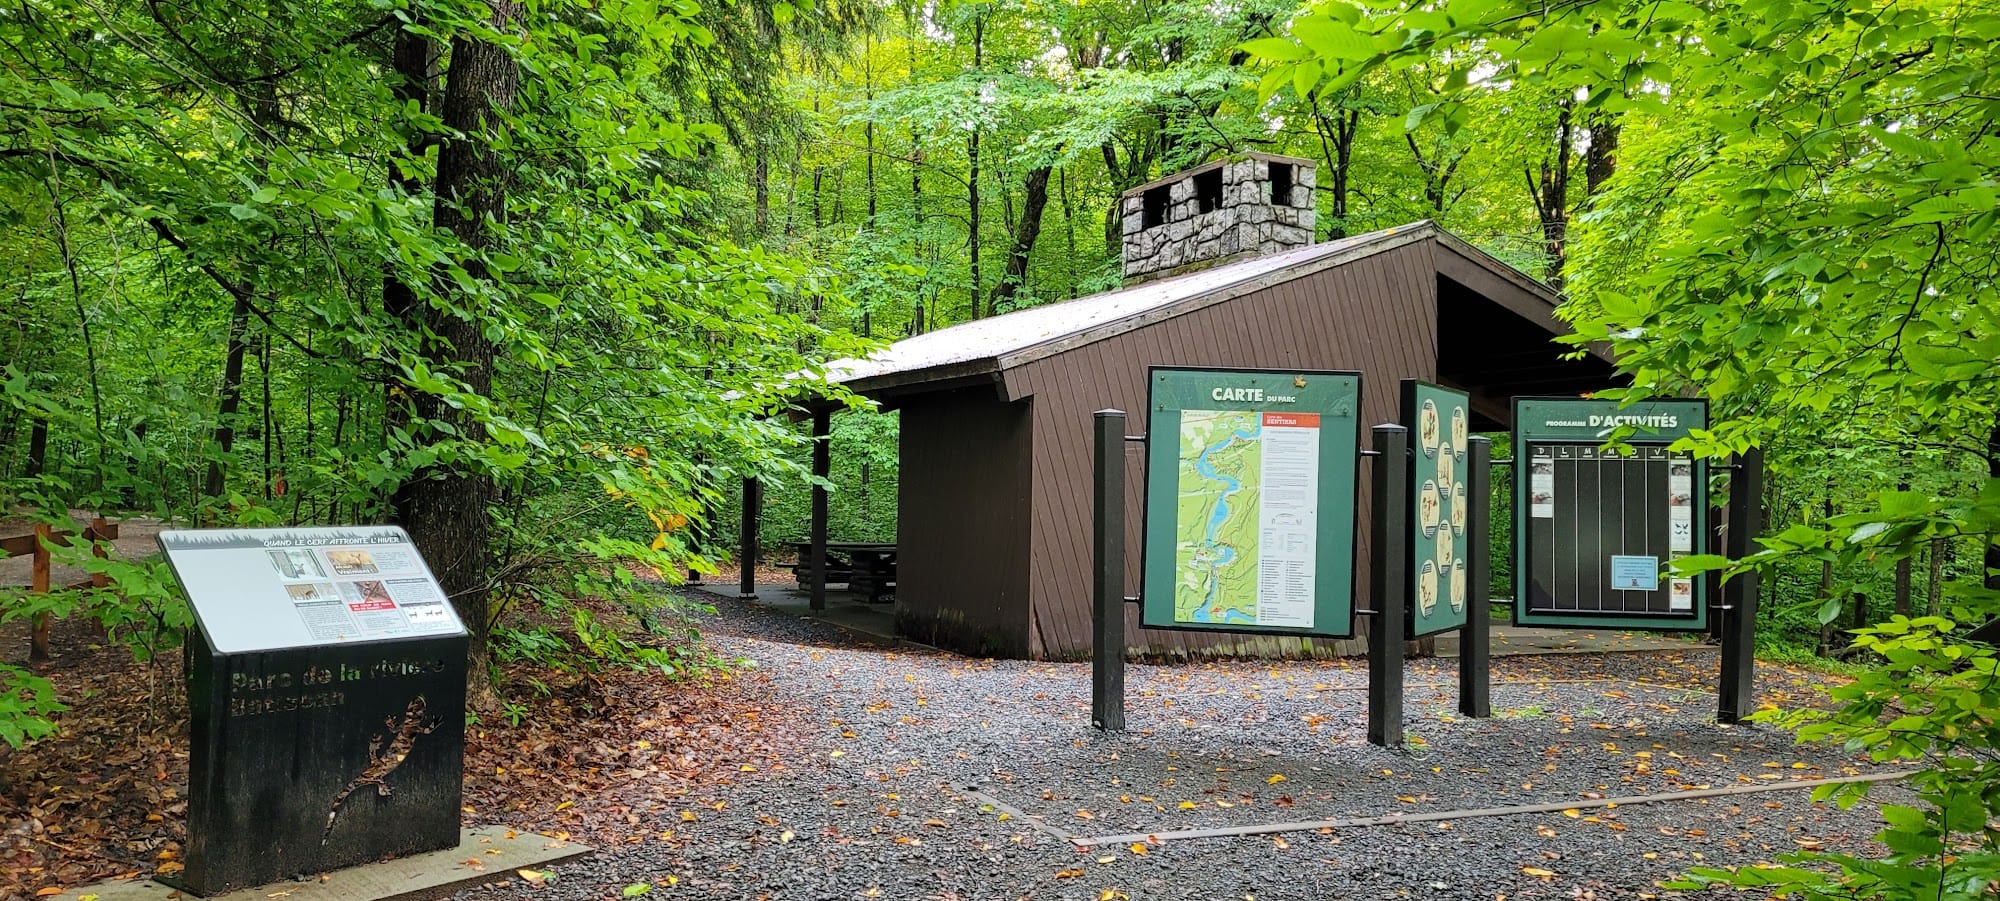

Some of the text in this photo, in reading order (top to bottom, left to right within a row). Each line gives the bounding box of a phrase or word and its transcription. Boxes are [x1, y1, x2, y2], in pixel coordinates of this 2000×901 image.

[1211, 387, 1264, 402] CARTE
[1589, 412, 1678, 428] D'ACTIVITÉS
[1537, 447, 1545, 455] D
[1584, 447, 1592, 455] M
[1607, 447, 1615, 455] M
[1654, 447, 1661, 455] V
[263, 539, 292, 547] QUAND
[307, 538, 329, 546] CERF
[329, 537, 368, 545] AFFRONTE
[370, 536, 401, 544] L'HIVER
[231, 672, 293, 692] Parc
[302, 665, 333, 685] de
[340, 663, 361, 681] la
